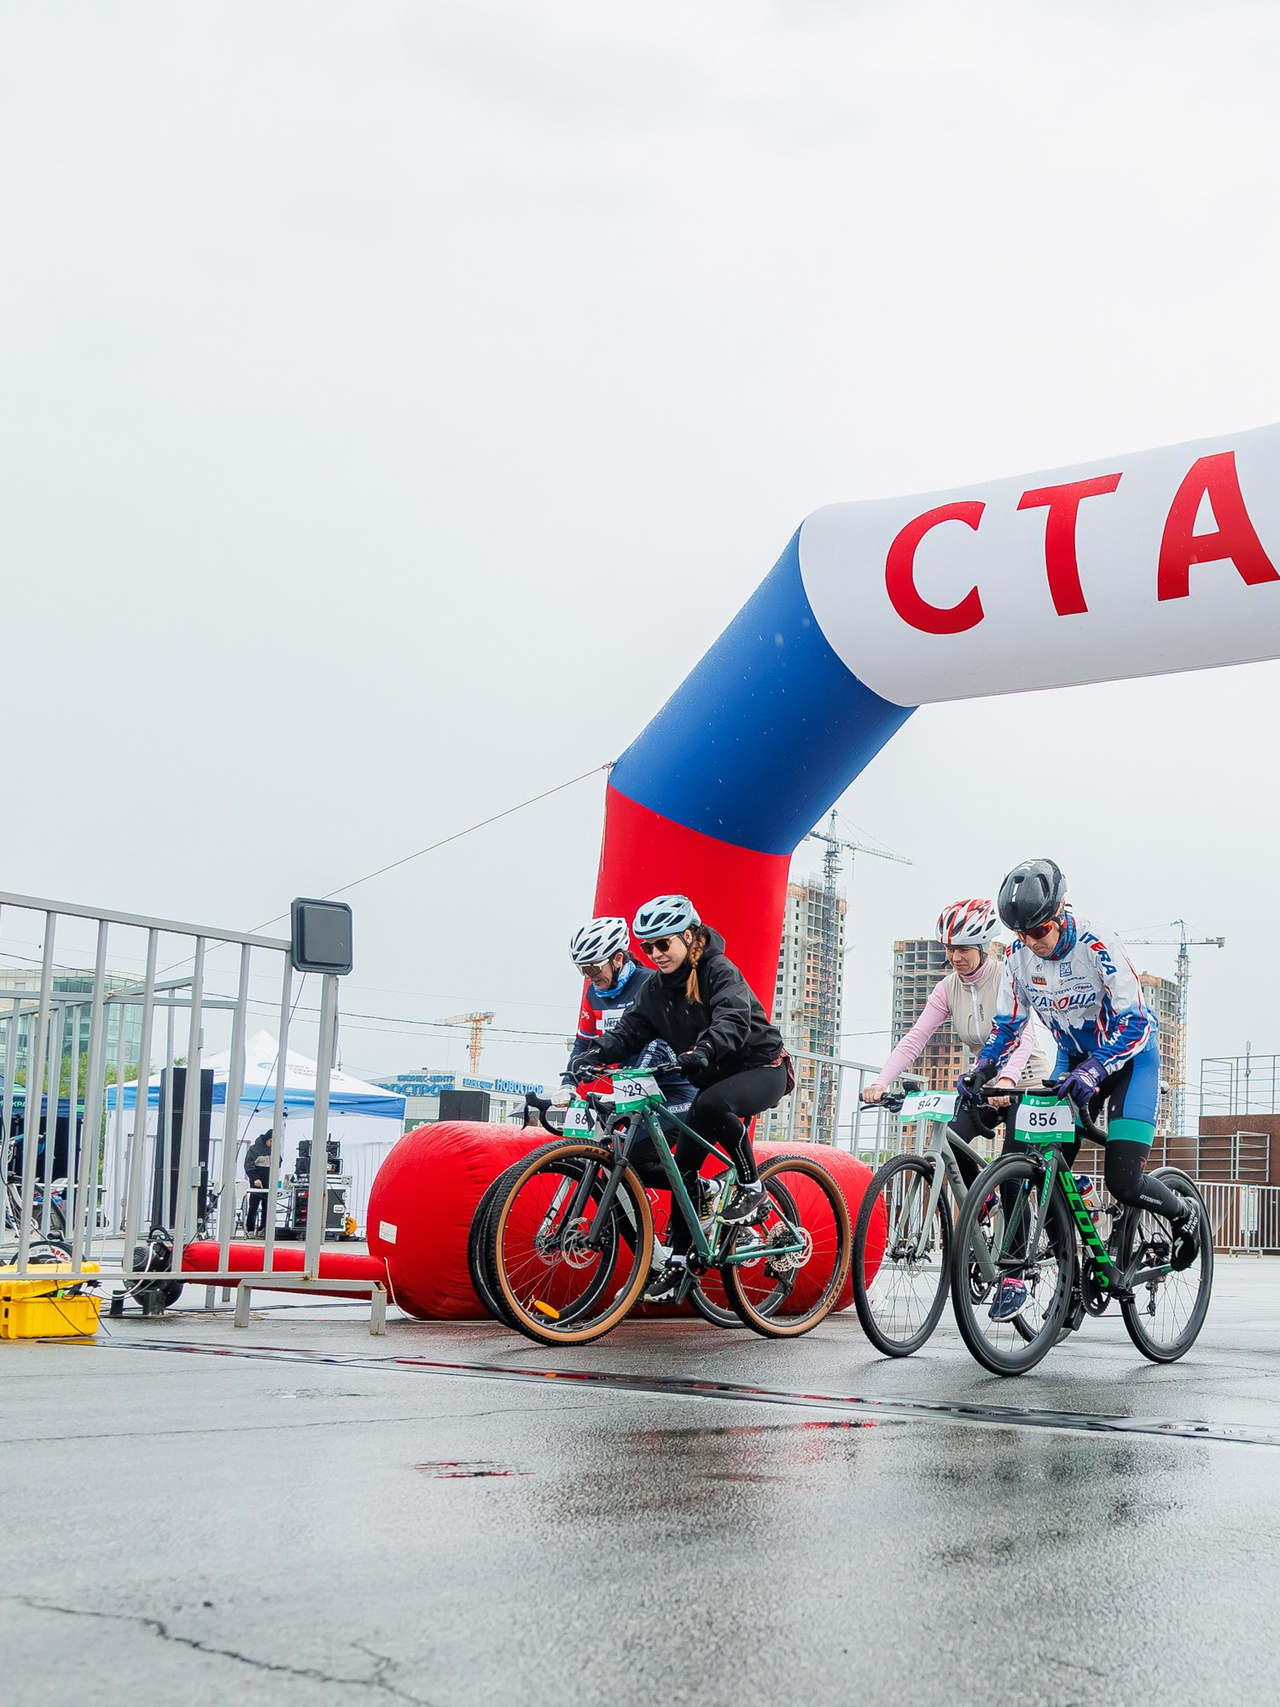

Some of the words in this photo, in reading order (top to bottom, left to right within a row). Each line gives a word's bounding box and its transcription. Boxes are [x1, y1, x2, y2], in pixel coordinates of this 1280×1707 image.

[1078, 932, 1118, 976] ITERA
[917, 1096, 941, 1110] 847
[575, 1112, 587, 1125] 86
[1029, 1111, 1057, 1127] 856
[1058, 1171, 1114, 1267] SCOTT
